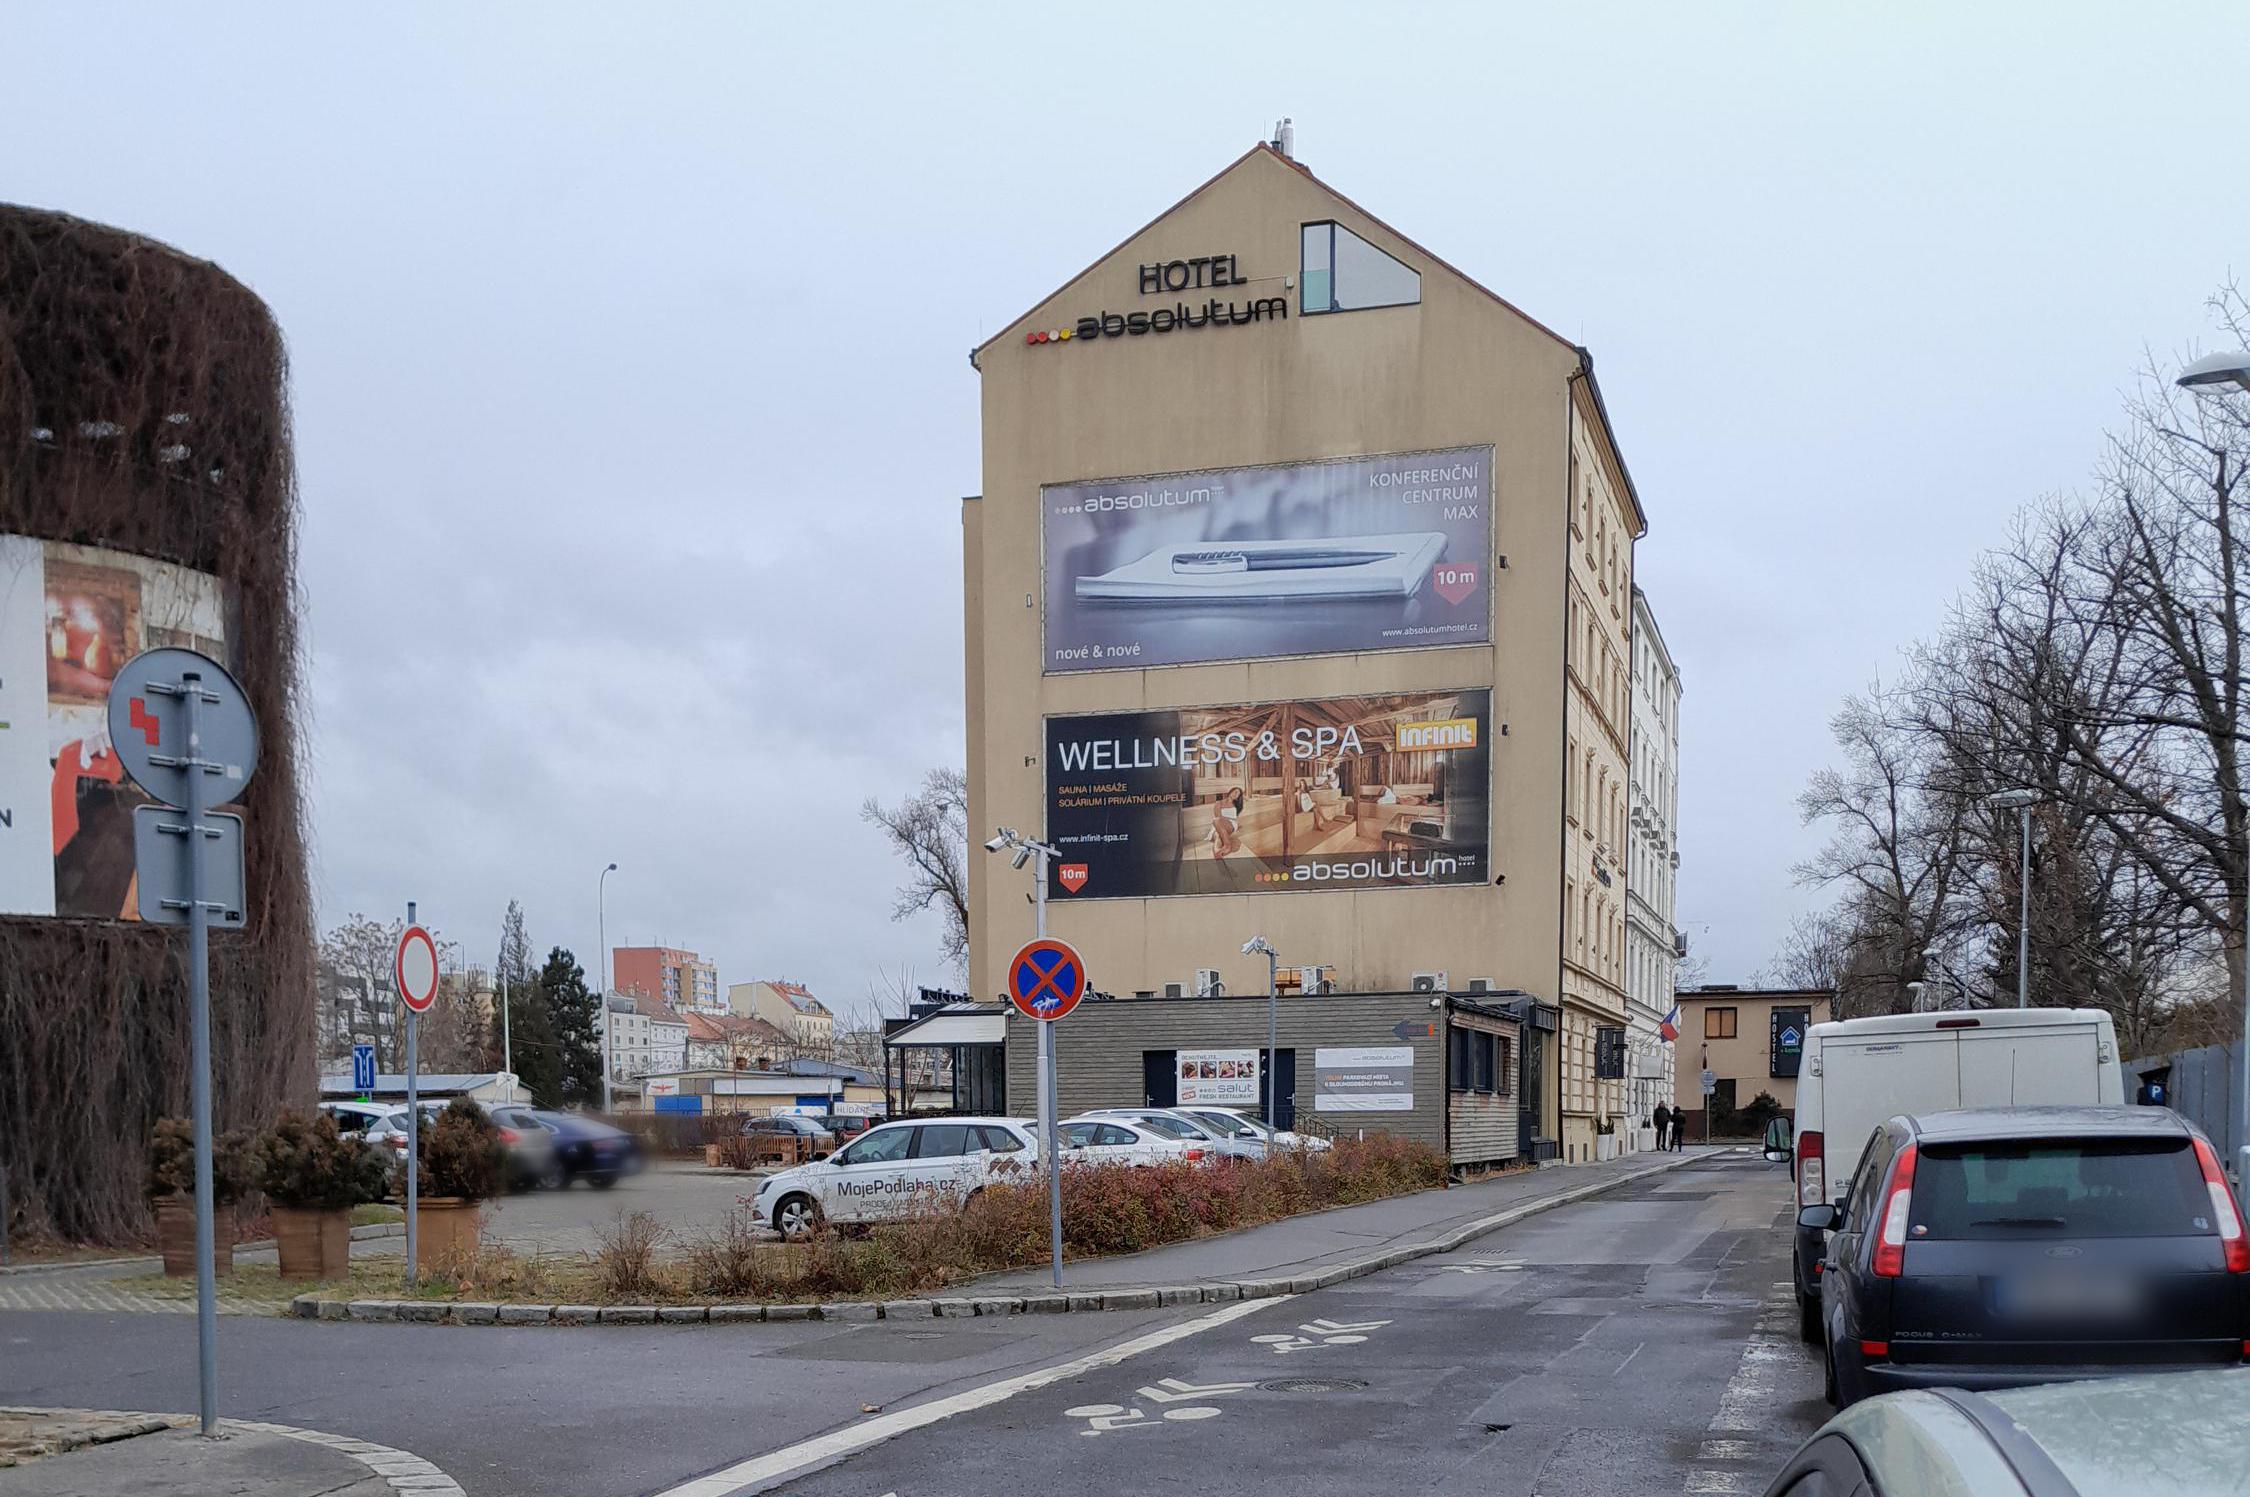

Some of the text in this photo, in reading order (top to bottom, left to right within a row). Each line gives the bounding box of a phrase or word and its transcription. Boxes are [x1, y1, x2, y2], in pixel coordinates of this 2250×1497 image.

[1139, 254, 1247, 294] HOTEL
[1076, 297, 1287, 340] absolutum
[1370, 462, 1479, 487] KONFERENČNÍ
[1084, 488, 1210, 512] absolutum
[1402, 485, 1478, 504] CENTRUM
[1444, 505, 1478, 520] MAX
[1437, 571, 1474, 585] 10 m
[1382, 623, 1478, 637] www.absolutumhotel.cz
[1055, 642, 1141, 661] nové & nové
[1058, 725, 1364, 771] WELLNESS & SPA
[1058, 786, 1087, 794] SAUNA
[1093, 783, 1127, 793] MASÁŽE
[1058, 797, 1102, 807] SOLÁRIUM
[1108, 795, 1146, 805] PRIVÁTNÍ
[1147, 793, 1186, 803] KOUPELE
[1059, 833, 1129, 843] www.infinit-spa.cz
[1293, 857, 1456, 882] absolutum
[1217, 1084, 1254, 1093] salut
[2152, 1086, 2161, 1098] P
[837, 1178, 956, 1198] MojePodlaha.cz
